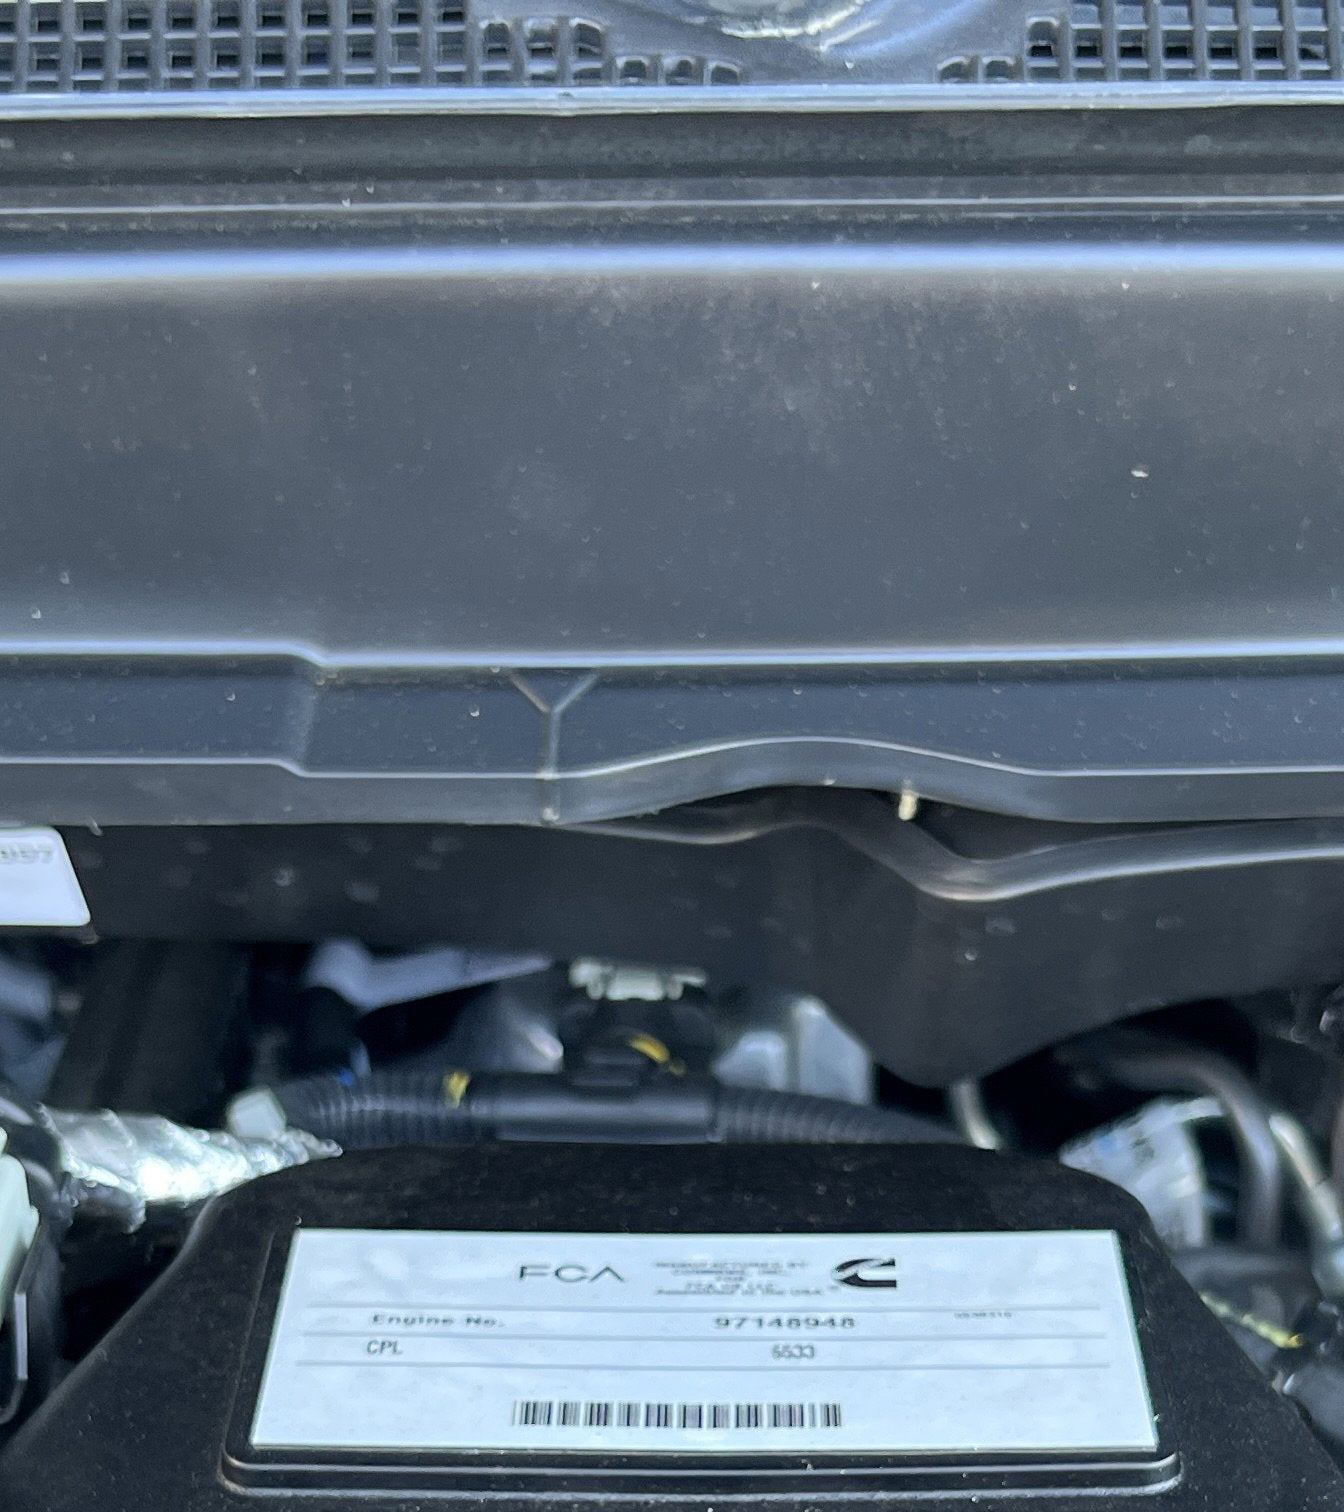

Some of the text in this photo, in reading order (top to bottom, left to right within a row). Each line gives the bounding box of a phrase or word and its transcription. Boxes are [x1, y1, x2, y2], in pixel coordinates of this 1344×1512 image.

[518, 1262, 626, 1283] FCA
[372, 1313, 454, 1327] Engine
[367, 1340, 404, 1356] CPL
